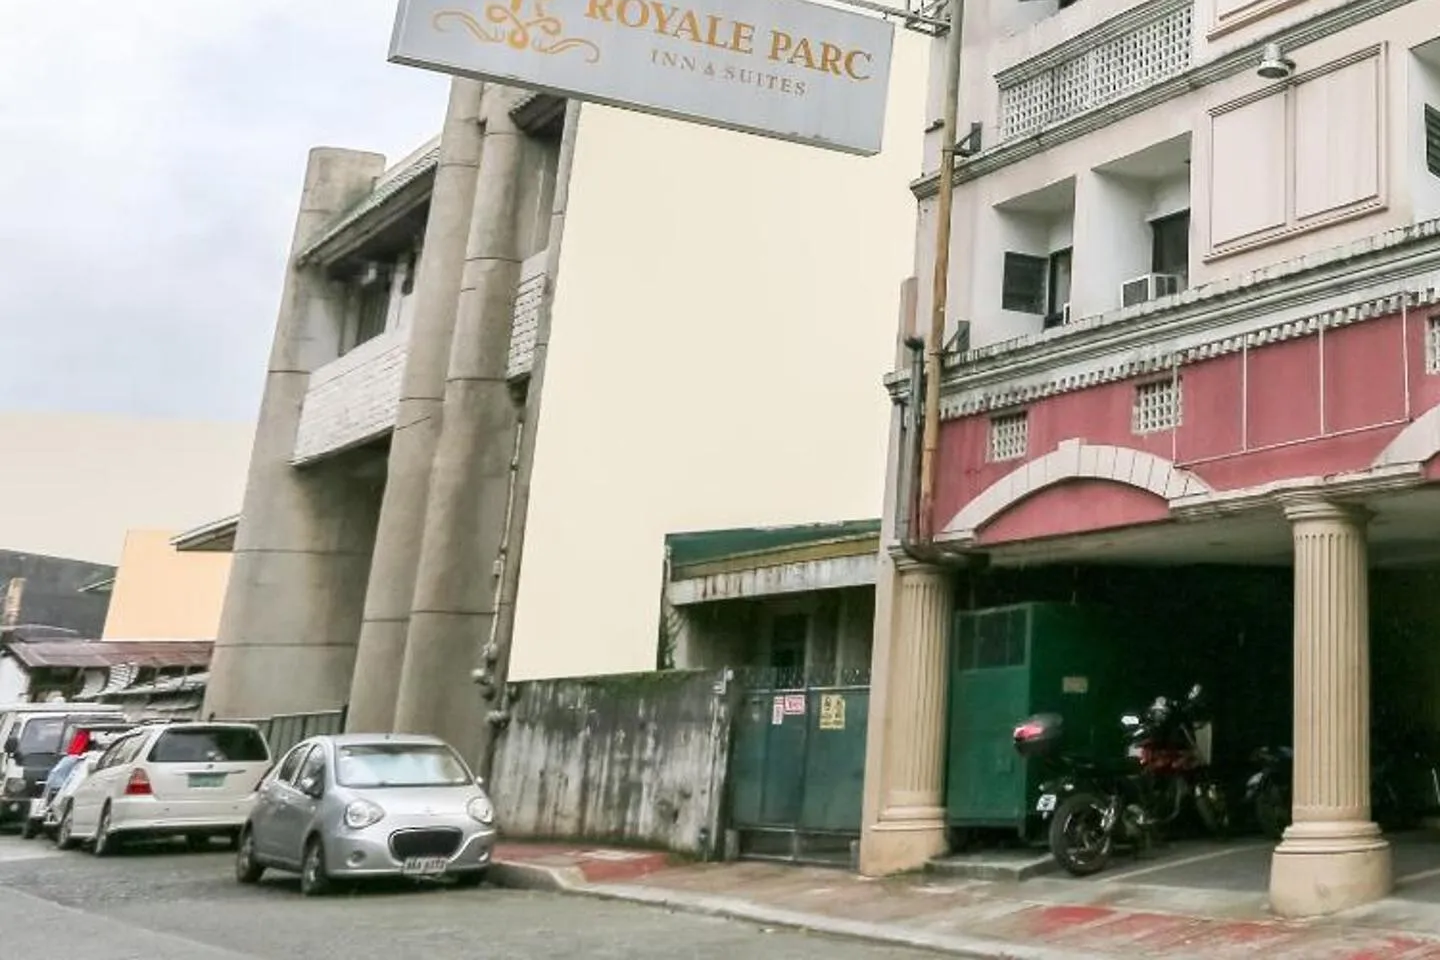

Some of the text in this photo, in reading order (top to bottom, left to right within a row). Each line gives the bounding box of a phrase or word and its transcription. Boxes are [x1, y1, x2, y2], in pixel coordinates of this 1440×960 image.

[650, 47, 807, 98] INN & SUITES
[768, 29, 874, 81] PARC
